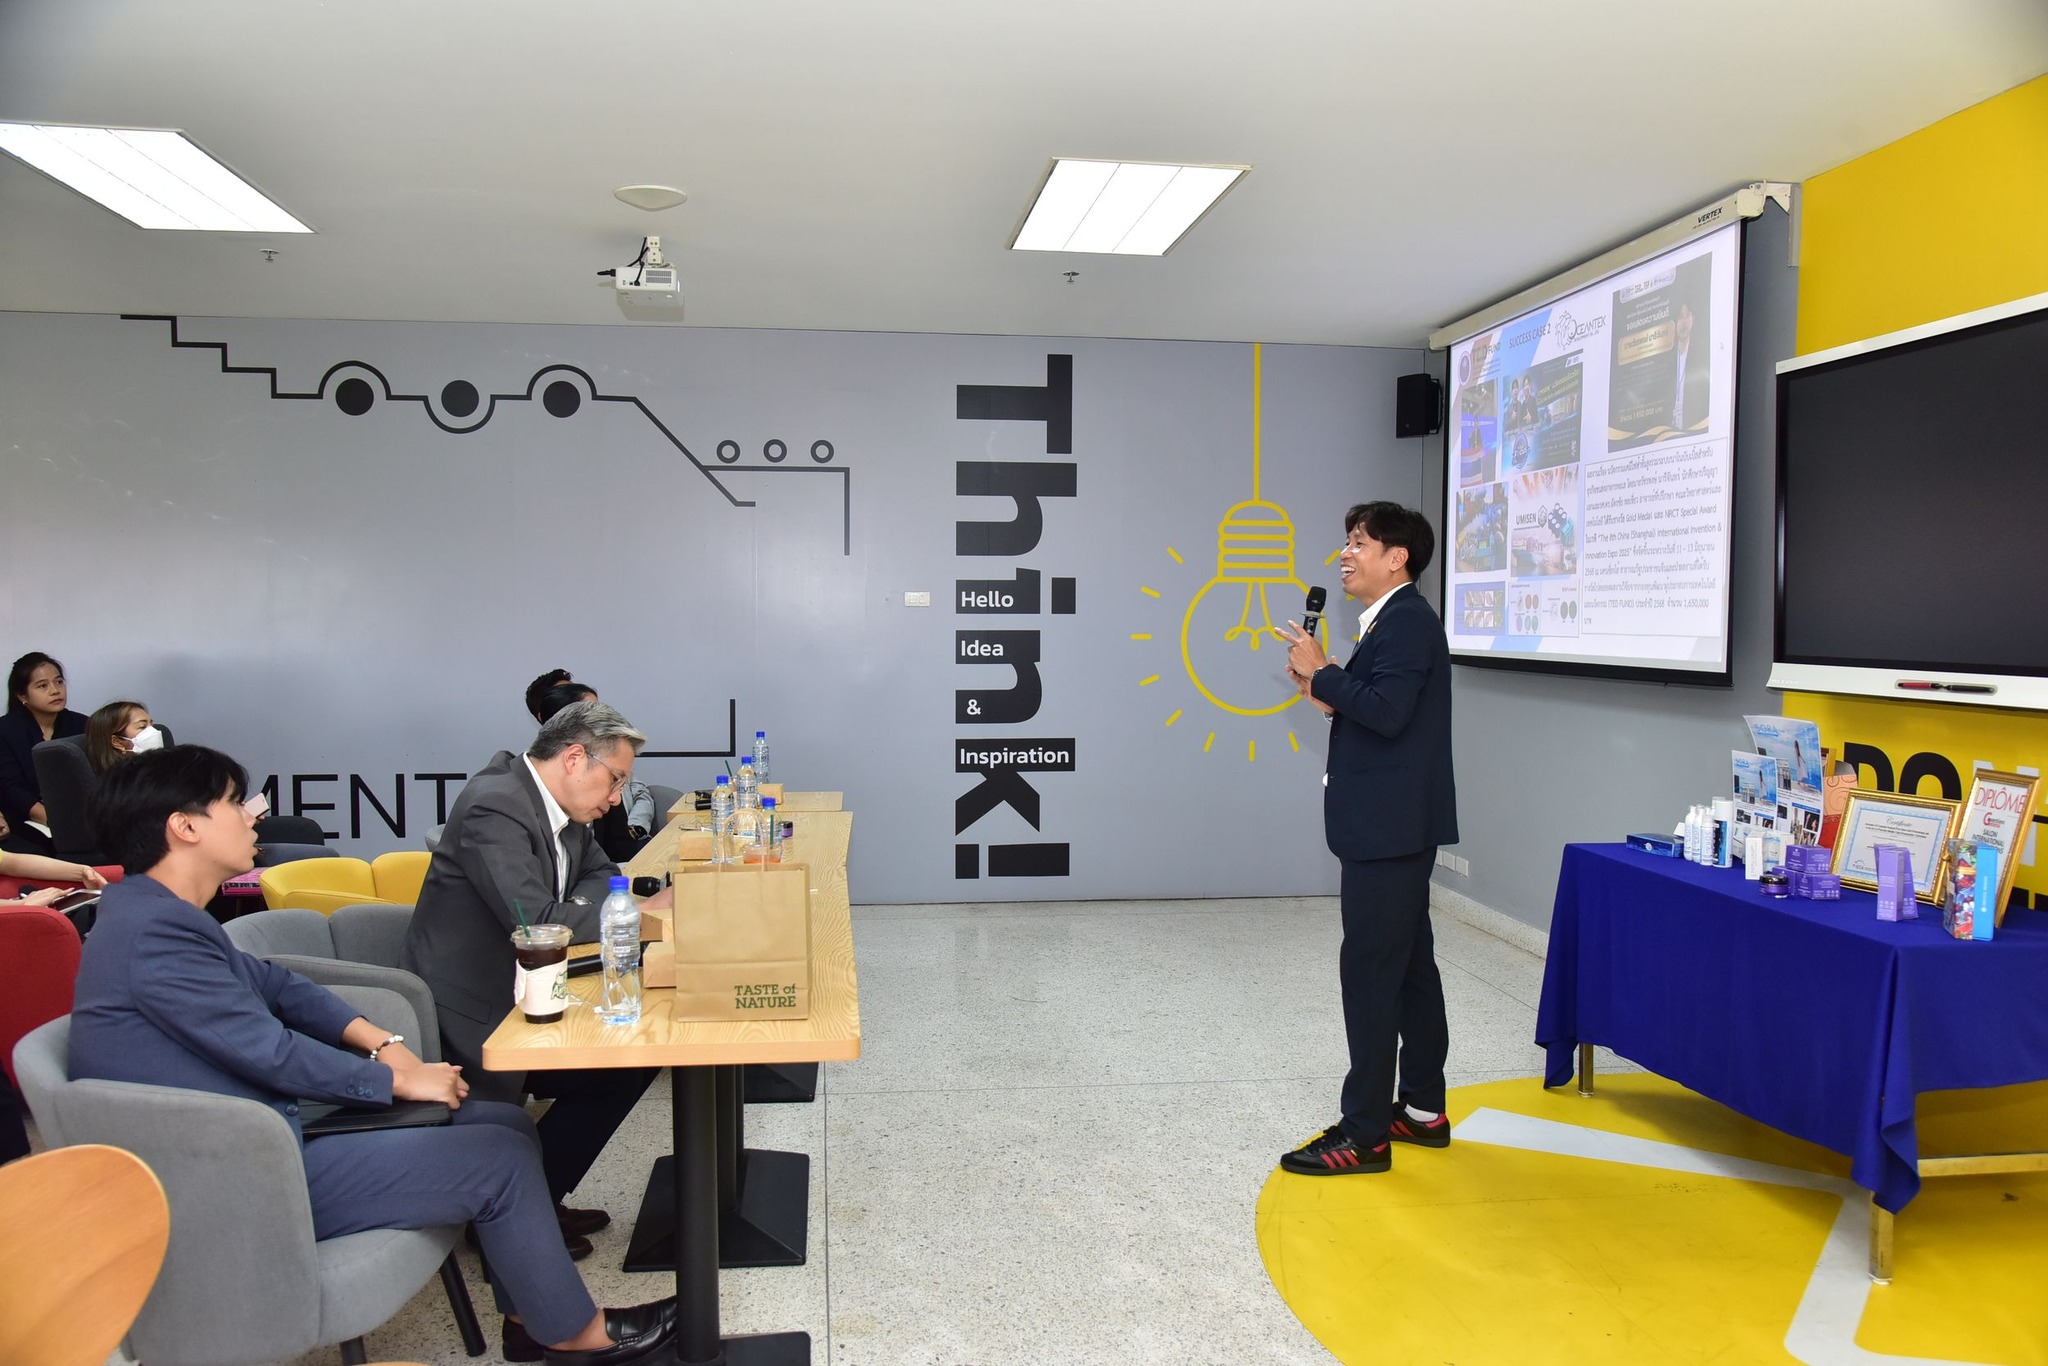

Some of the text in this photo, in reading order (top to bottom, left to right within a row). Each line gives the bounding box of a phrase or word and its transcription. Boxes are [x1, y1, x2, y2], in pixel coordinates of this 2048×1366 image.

[1698, 206, 1723, 223] VERTEX
[1508, 323, 1552, 349] SUCCESS CASE 2
[1516, 513, 1537, 525] UMISEN
[1626, 513, 1637, 522] Gold
[1638, 512, 1652, 521] Medal
[1665, 508, 1679, 518] NRCT
[1680, 507, 1698, 518] Special
[1699, 504, 1717, 514] Award
[1617, 532, 1629, 540] China
[1631, 529, 1656, 540] (Shanghai)
[1657, 526, 1689, 537] International
[1690, 524, 1716, 533] Invention
[1608, 550, 1618, 559] Expo
[961, 591, 1014, 607] Hello
[961, 640, 1004, 656] Idea
[966, 699, 981, 715] &
[960, 748, 1069, 769] Inspiration
[734, 983, 796, 996] TASTE of
[735, 996, 796, 1009] NATURE
